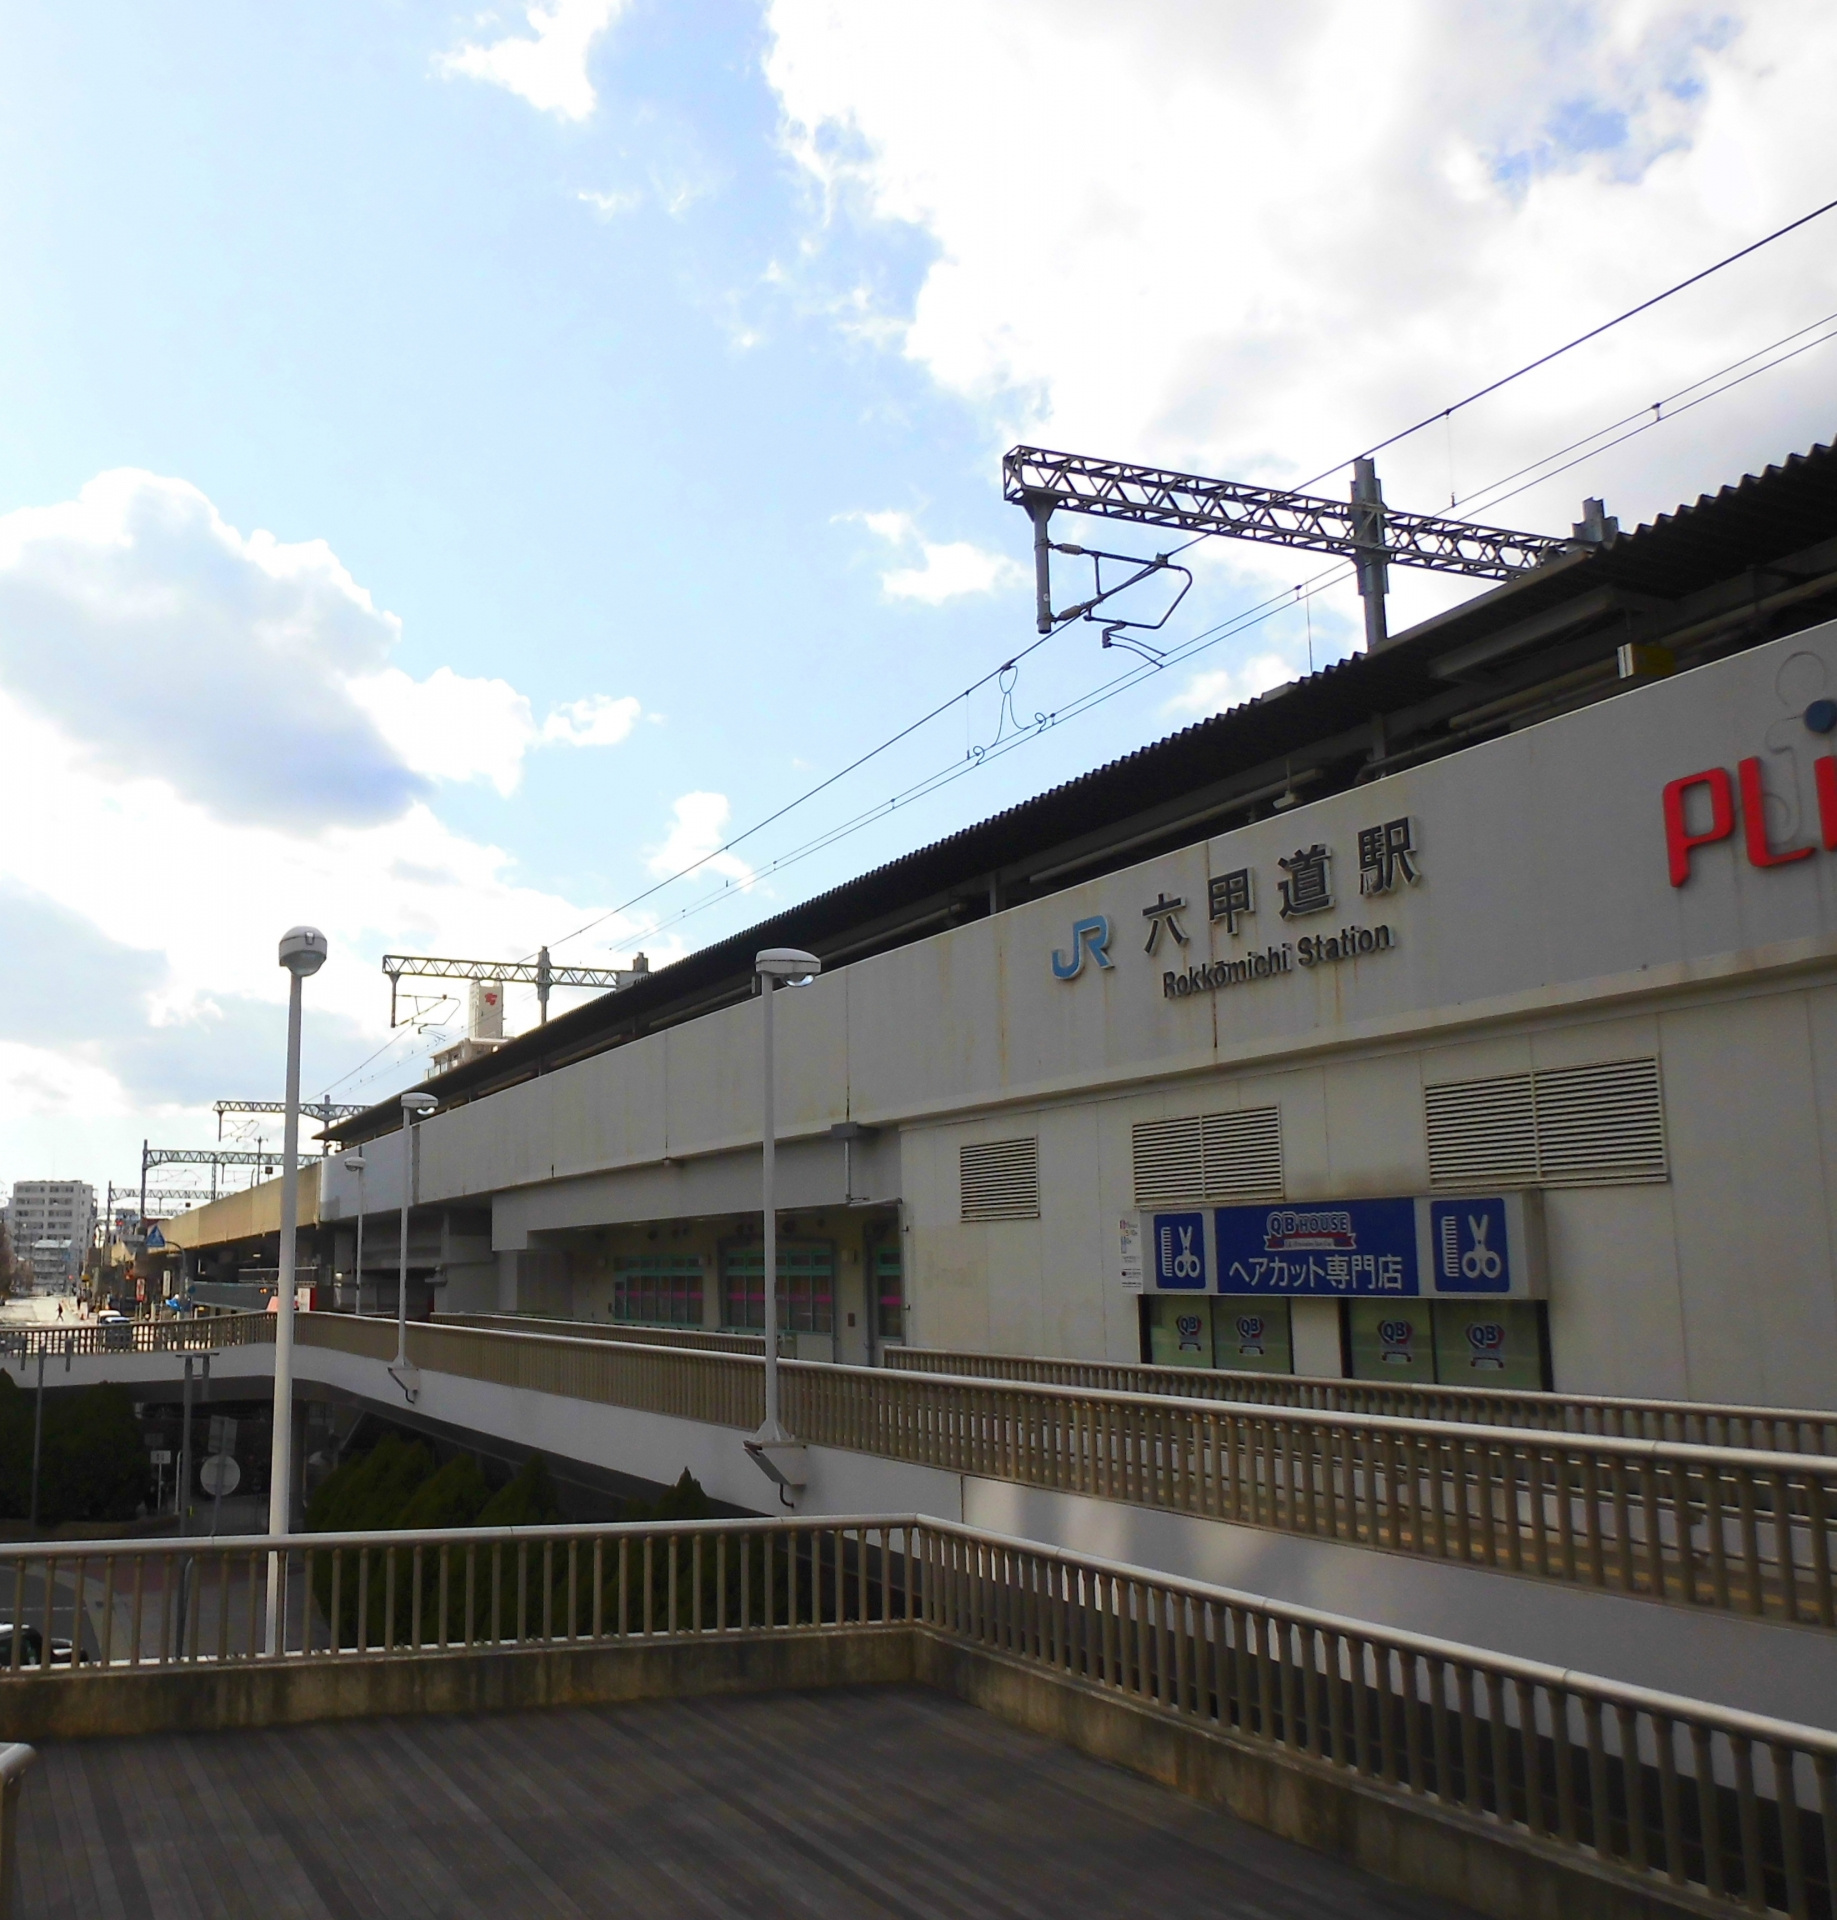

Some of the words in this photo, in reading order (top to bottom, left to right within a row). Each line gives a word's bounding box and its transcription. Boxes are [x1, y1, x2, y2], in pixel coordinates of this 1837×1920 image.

[1142, 815, 1421, 956] 六甲道駅
[1051, 914, 1115, 980] JR
[1297, 924, 1396, 967] Station
[1267, 1212, 1297, 1237] QB
[1299, 1214, 1348, 1232] HOUSE
[1229, 1254, 1402, 1290] ヘアカット専門店
[1180, 1316, 1197, 1333] QB
[1241, 1318, 1259, 1336] QB
[1383, 1321, 1405, 1341] QB
[1472, 1325, 1497, 1346] QB
